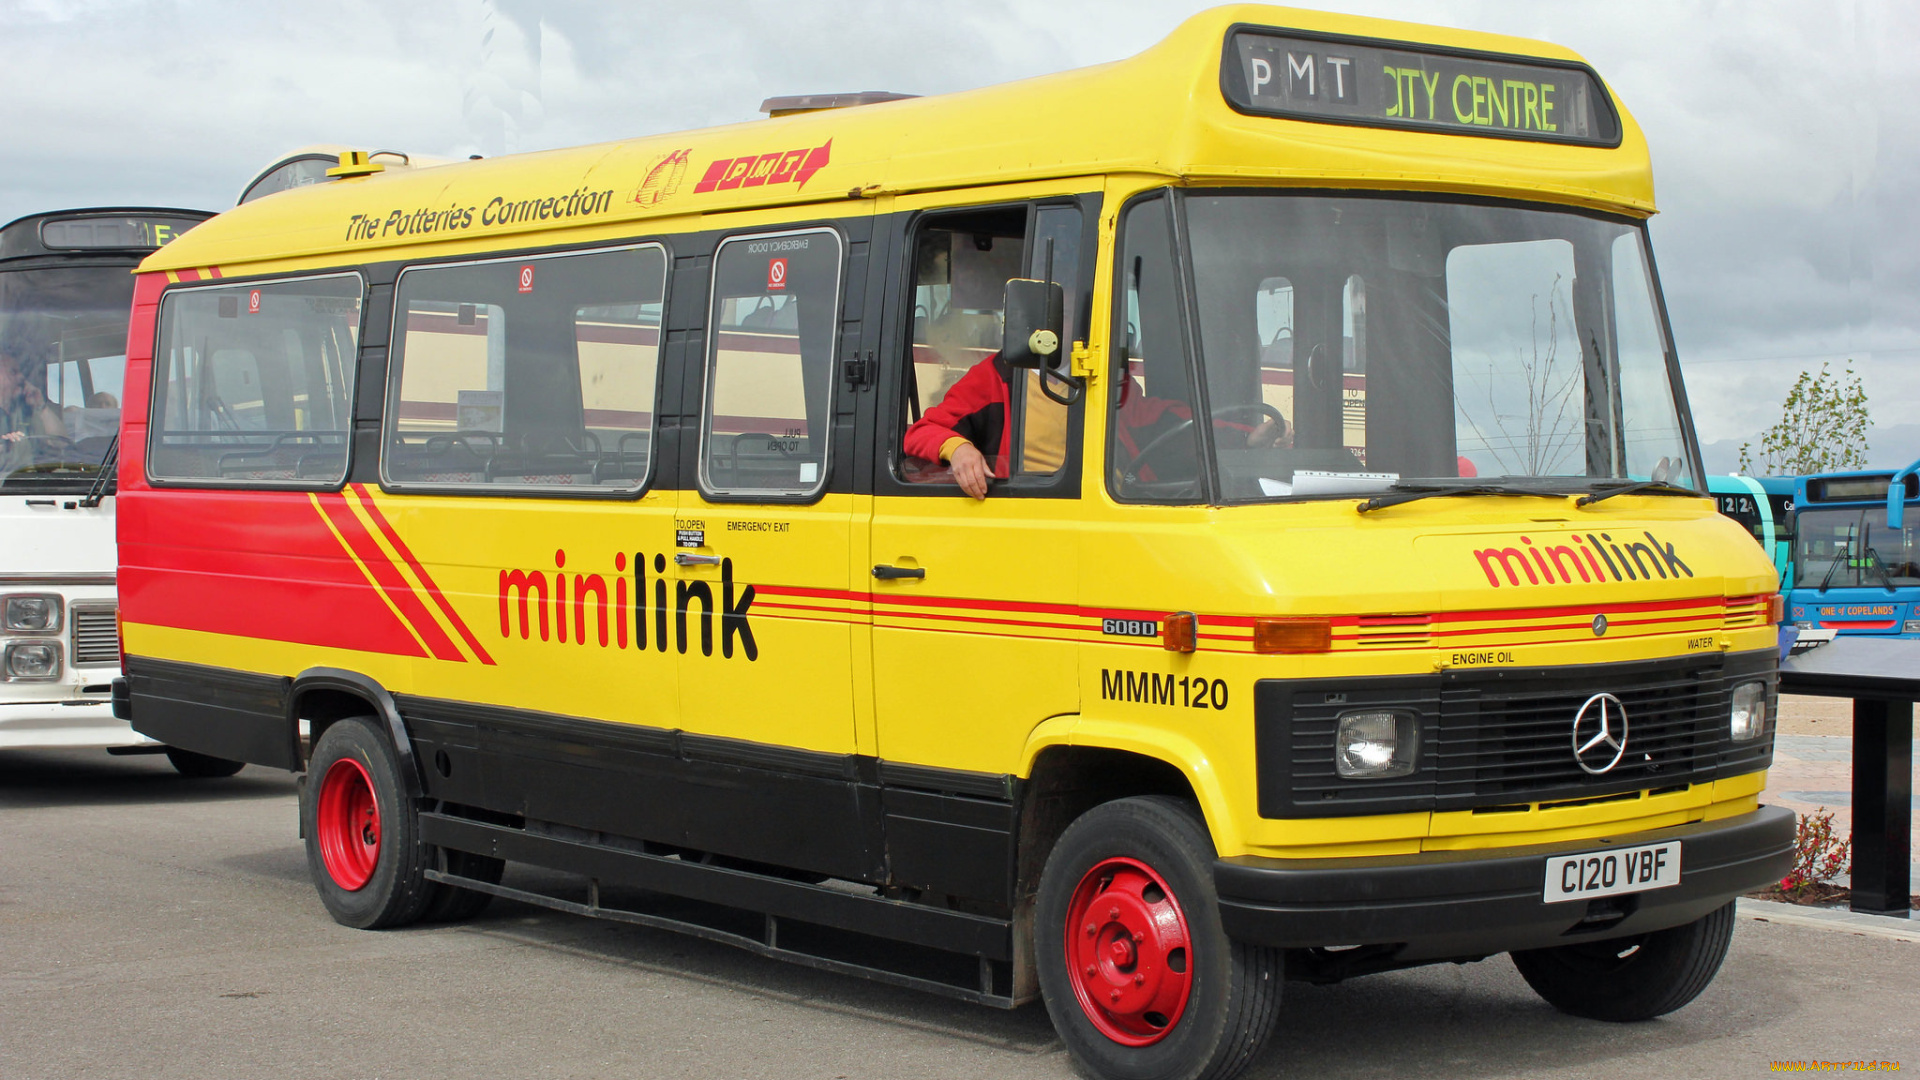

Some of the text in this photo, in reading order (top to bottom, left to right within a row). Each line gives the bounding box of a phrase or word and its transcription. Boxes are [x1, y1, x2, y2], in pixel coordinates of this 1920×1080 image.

[1451, 73, 1557, 132] CENTRE
[726, 154, 801, 182] PMT
[345, 186, 614, 242] The Potteries Connection
[727, 521, 790, 532] EMERGENCY EXIT
[1473, 530, 1694, 588] minilink
[499, 548, 758, 662] minilink
[1820, 605, 1894, 616] ONE of COPELANDS
[1452, 651, 1515, 666] ENGINE OIL
[1687, 637, 1714, 650] WATER
[1101, 668, 1229, 711] MMM120
[1561, 847, 1668, 893] C120 VBF
